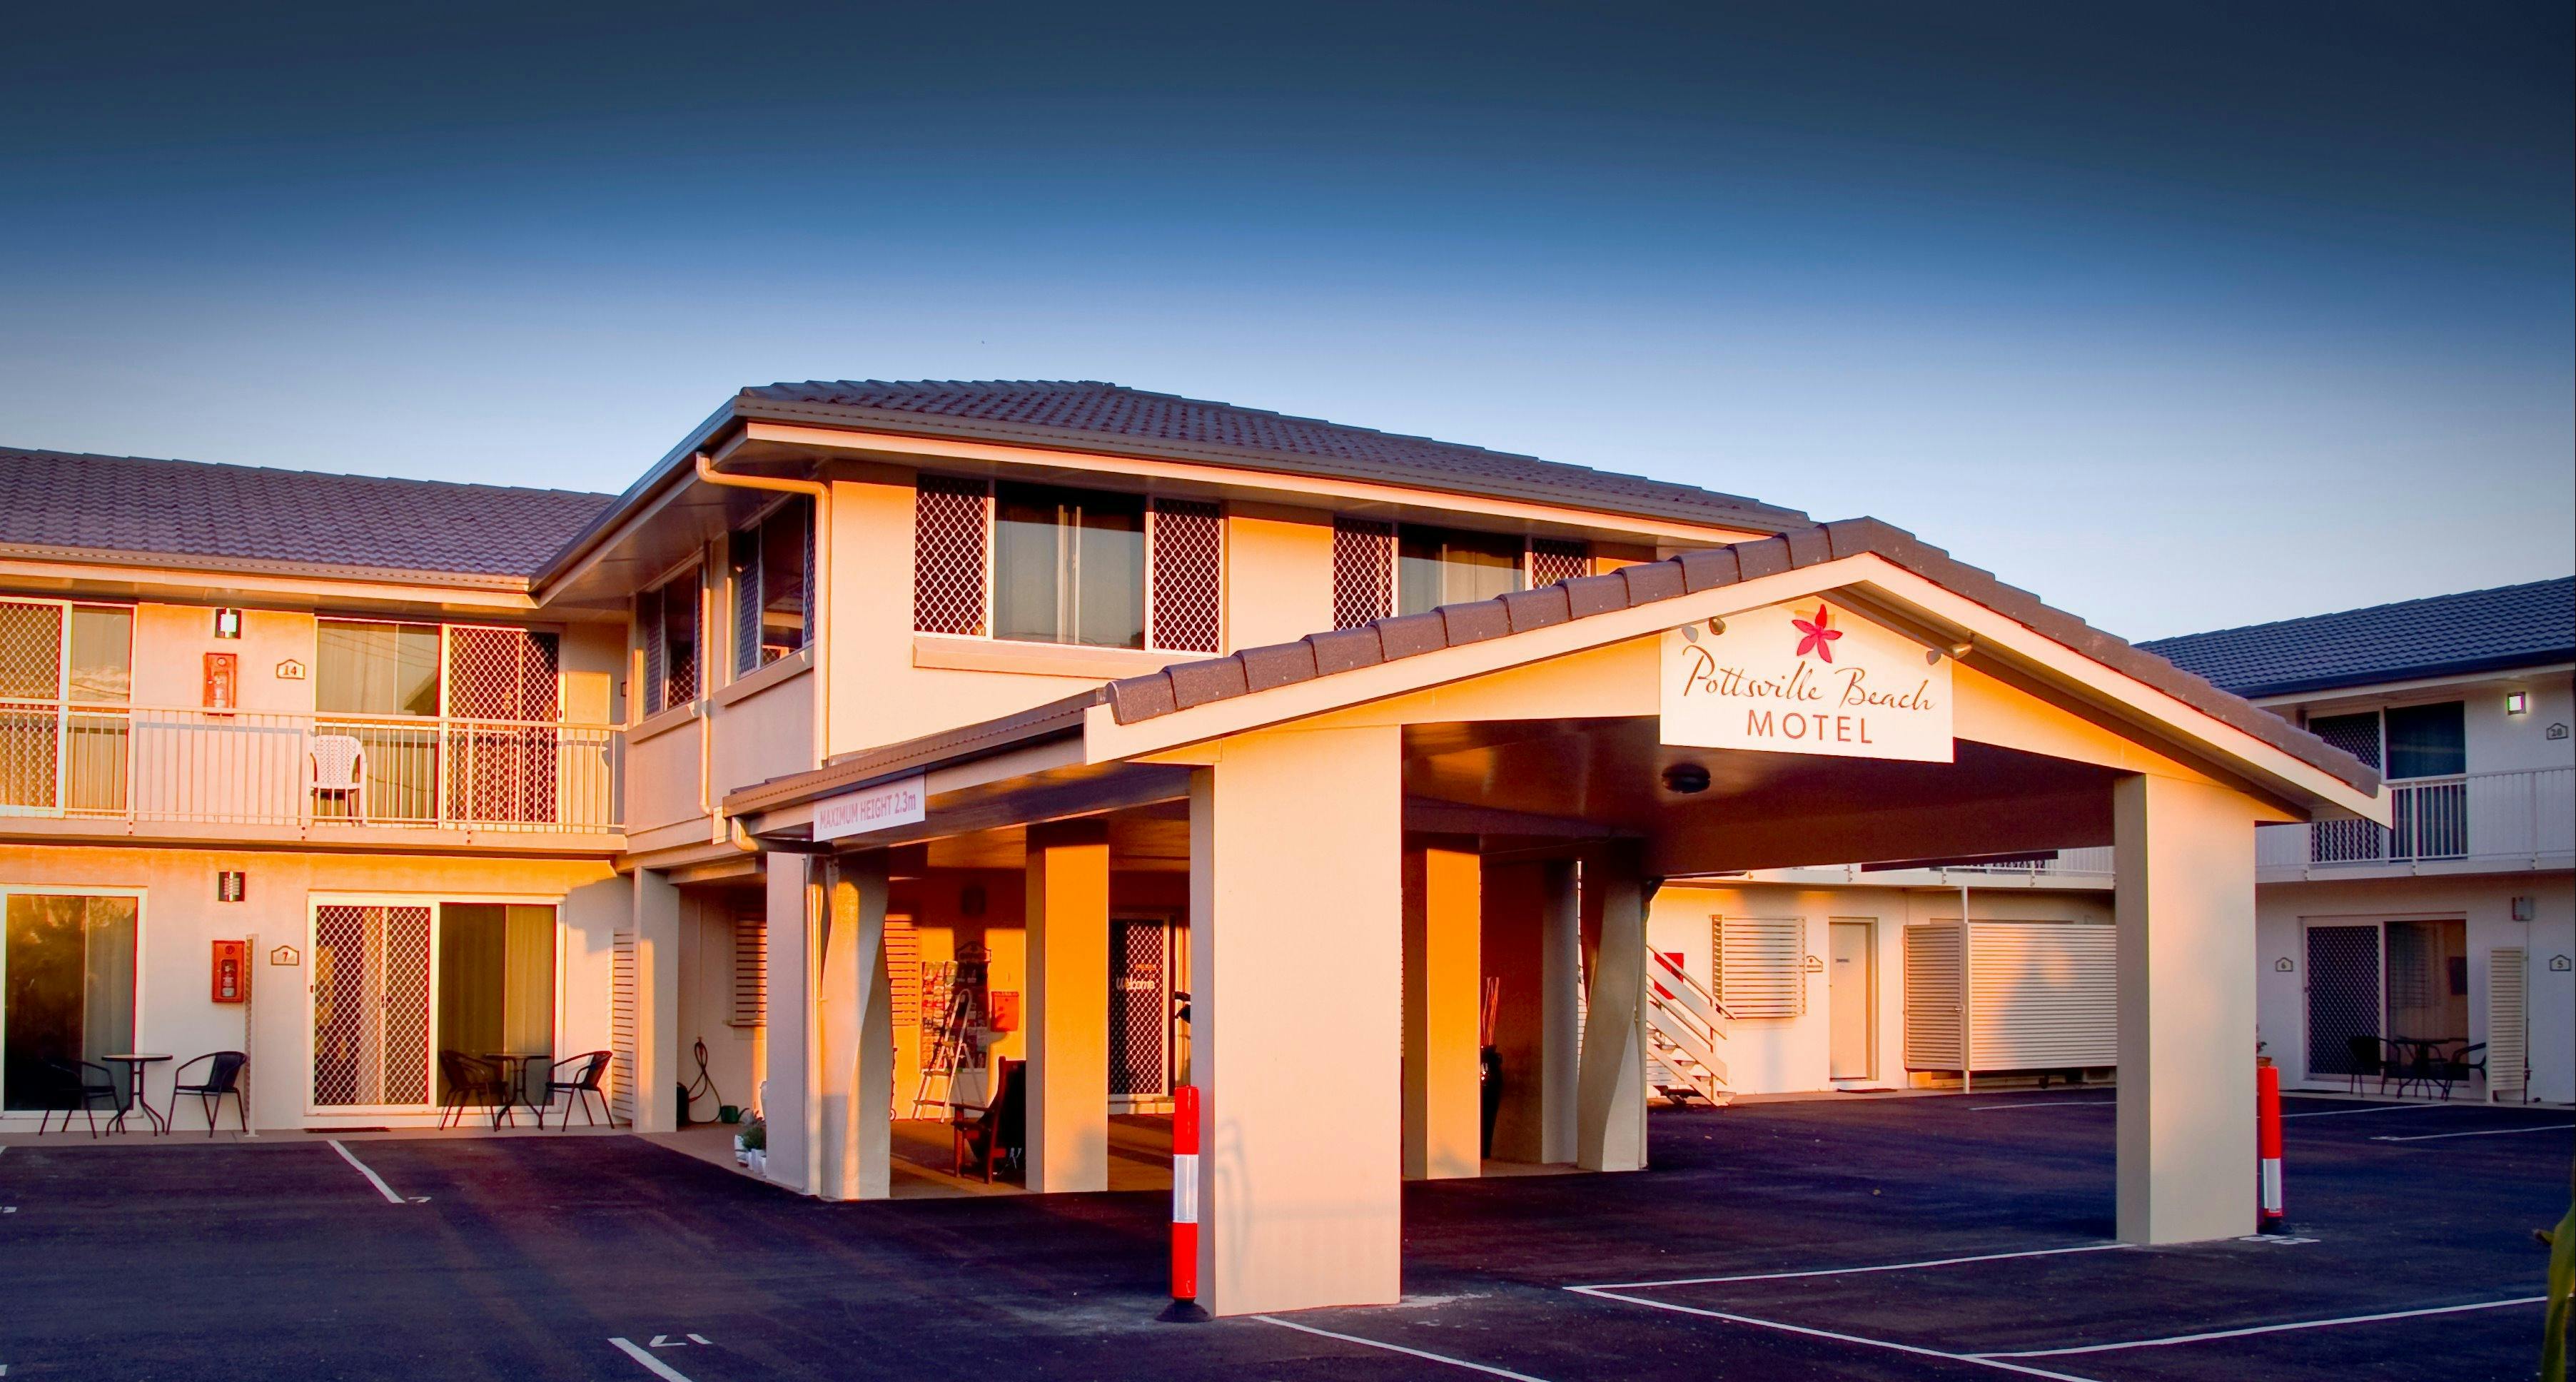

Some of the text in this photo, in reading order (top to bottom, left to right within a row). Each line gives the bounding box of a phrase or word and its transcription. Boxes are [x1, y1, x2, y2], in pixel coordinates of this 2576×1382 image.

[283, 665, 297, 675] 14
[1682, 645, 1936, 710] Pottsville Beach
[1747, 710, 1872, 744] MOTEL
[820, 791, 916, 829] MAXIMUM HEIGHT 2.3m
